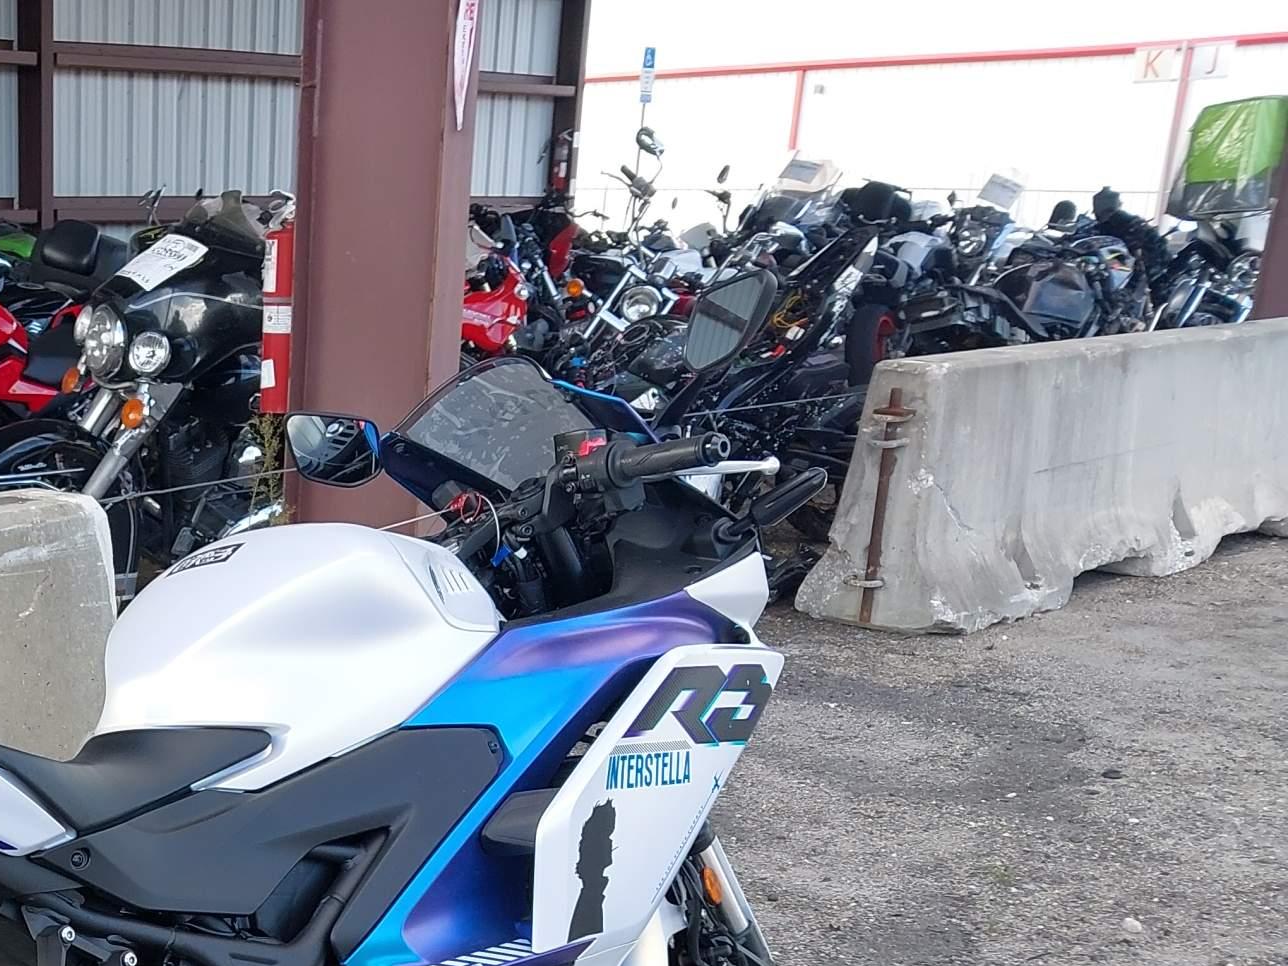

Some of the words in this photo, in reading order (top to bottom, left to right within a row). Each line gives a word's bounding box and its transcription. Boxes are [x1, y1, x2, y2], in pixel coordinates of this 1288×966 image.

[1143, 50, 1163, 79] K
[1205, 45, 1221, 75] J
[621, 663, 773, 748] R3
[605, 750, 692, 791] INTERSTELLA
